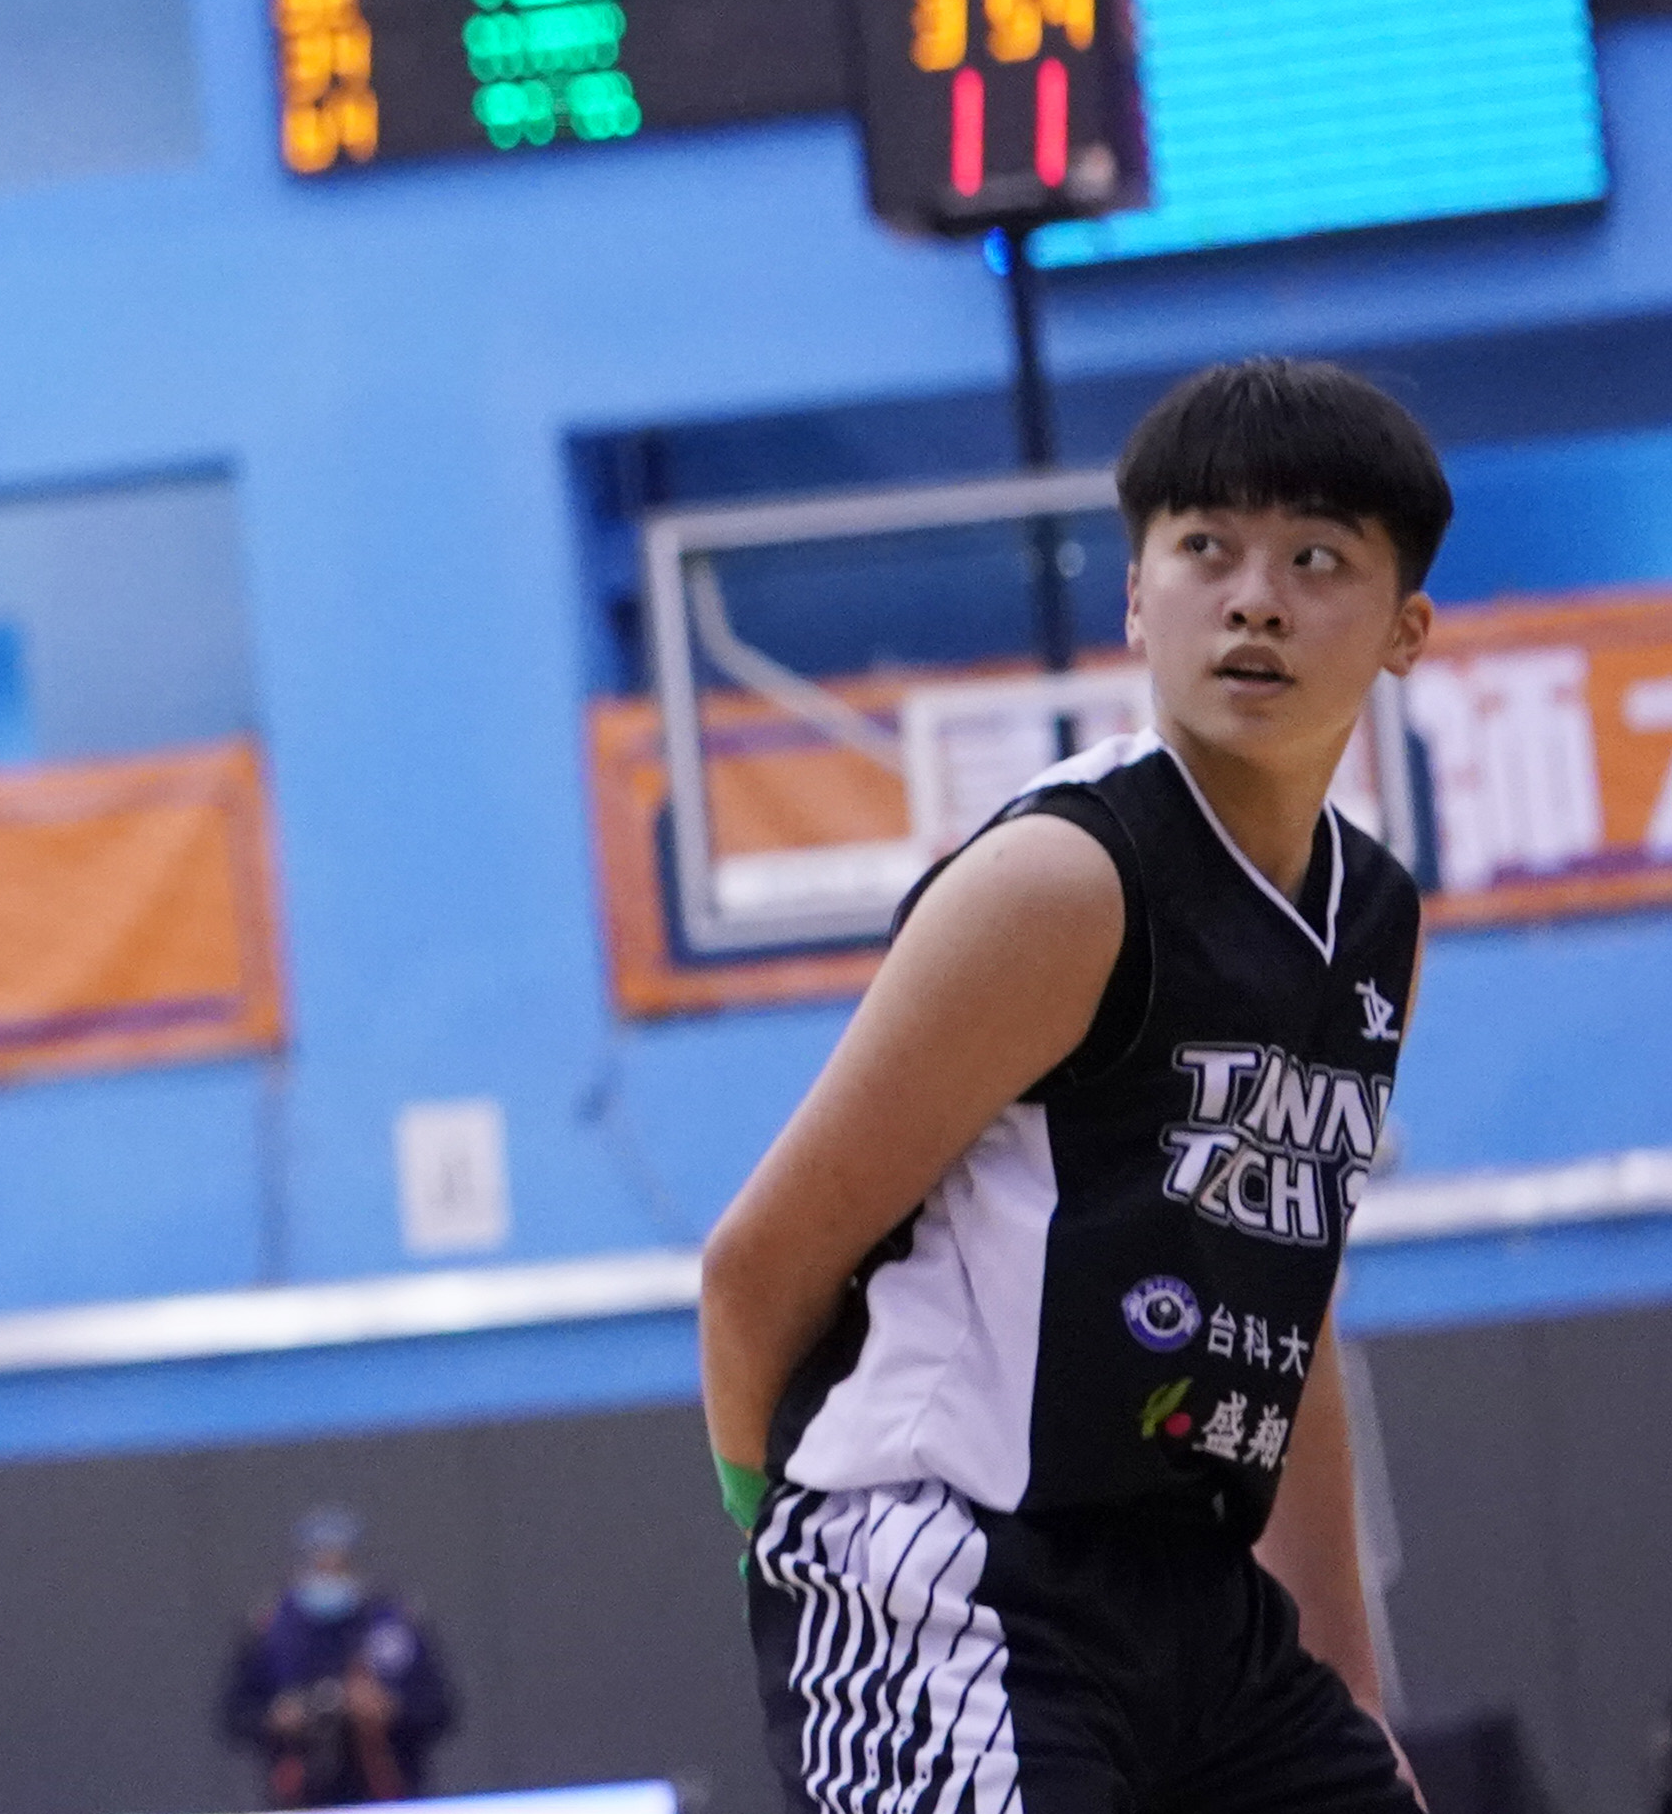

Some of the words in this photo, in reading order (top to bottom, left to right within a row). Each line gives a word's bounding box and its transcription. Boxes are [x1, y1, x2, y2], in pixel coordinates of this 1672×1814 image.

[949, 55, 1069, 198] 11
[1172, 1042, 1392, 1160] TWA
[1207, 1301, 1310, 1379] 台科大
[1191, 1389, 1290, 1472] 盛翔
